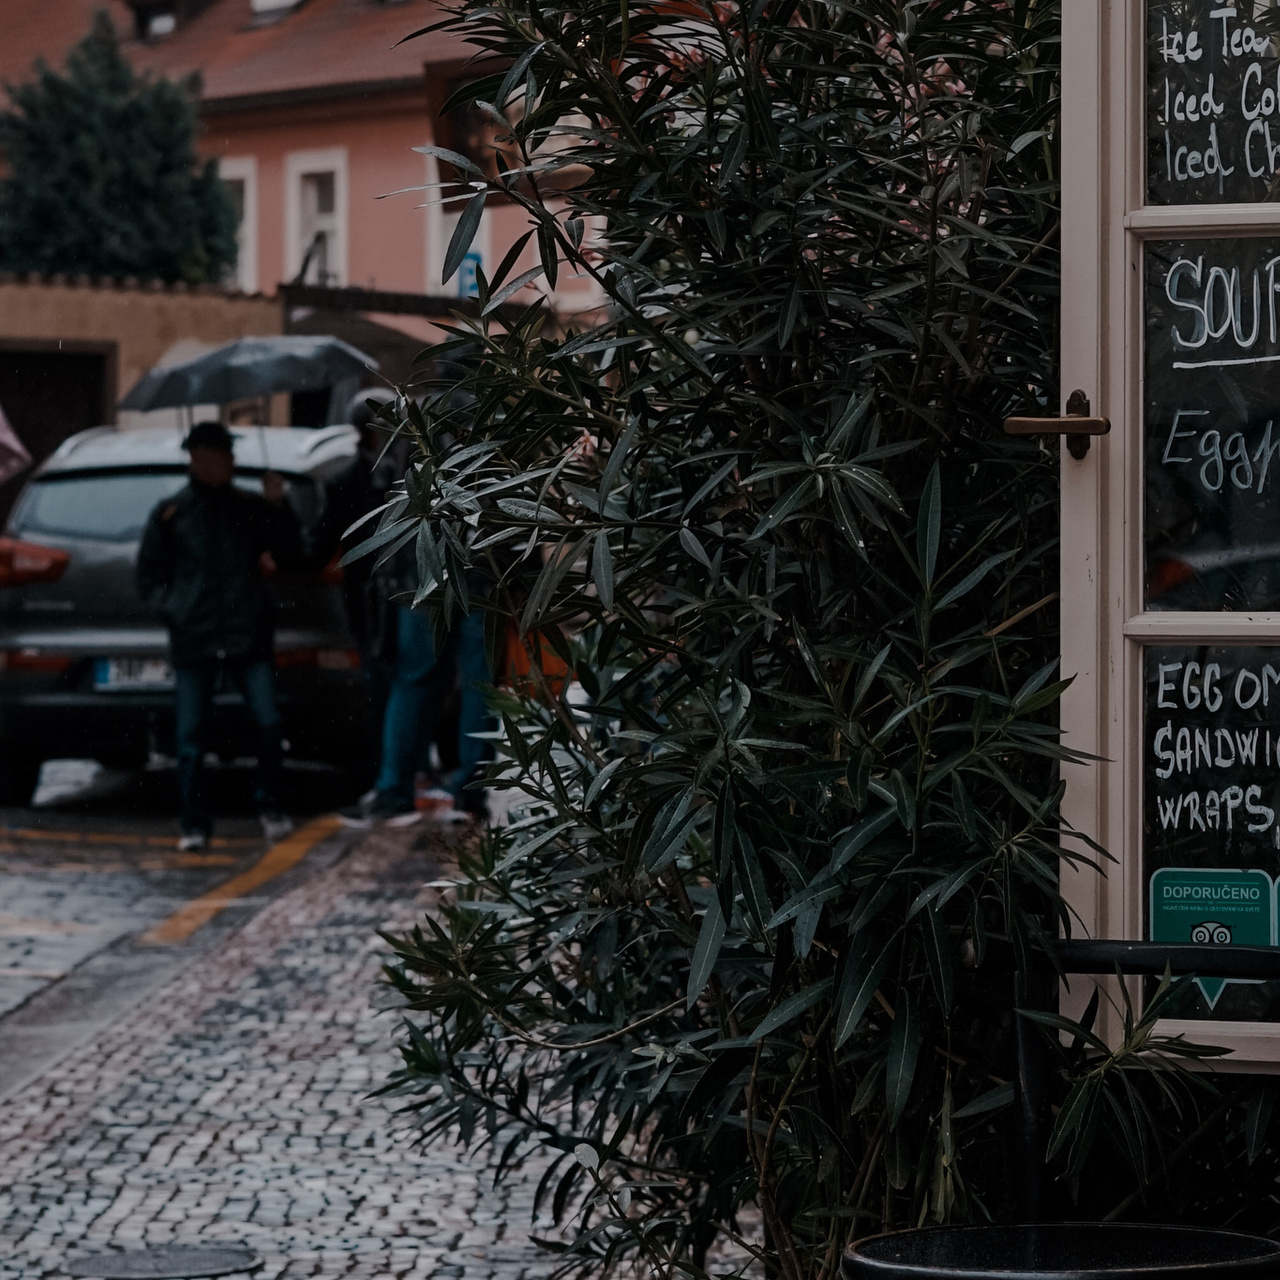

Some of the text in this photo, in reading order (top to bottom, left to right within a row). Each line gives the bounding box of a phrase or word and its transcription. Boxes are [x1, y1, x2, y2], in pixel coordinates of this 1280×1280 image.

[1209, 8, 1270, 57] Tea
[1164, 74, 1225, 123] Iced
[1164, 122, 1235, 183] Iced
[1157, 661, 1222, 713] EGG
[1162, 884, 1260, 900] DOPORUČENO
